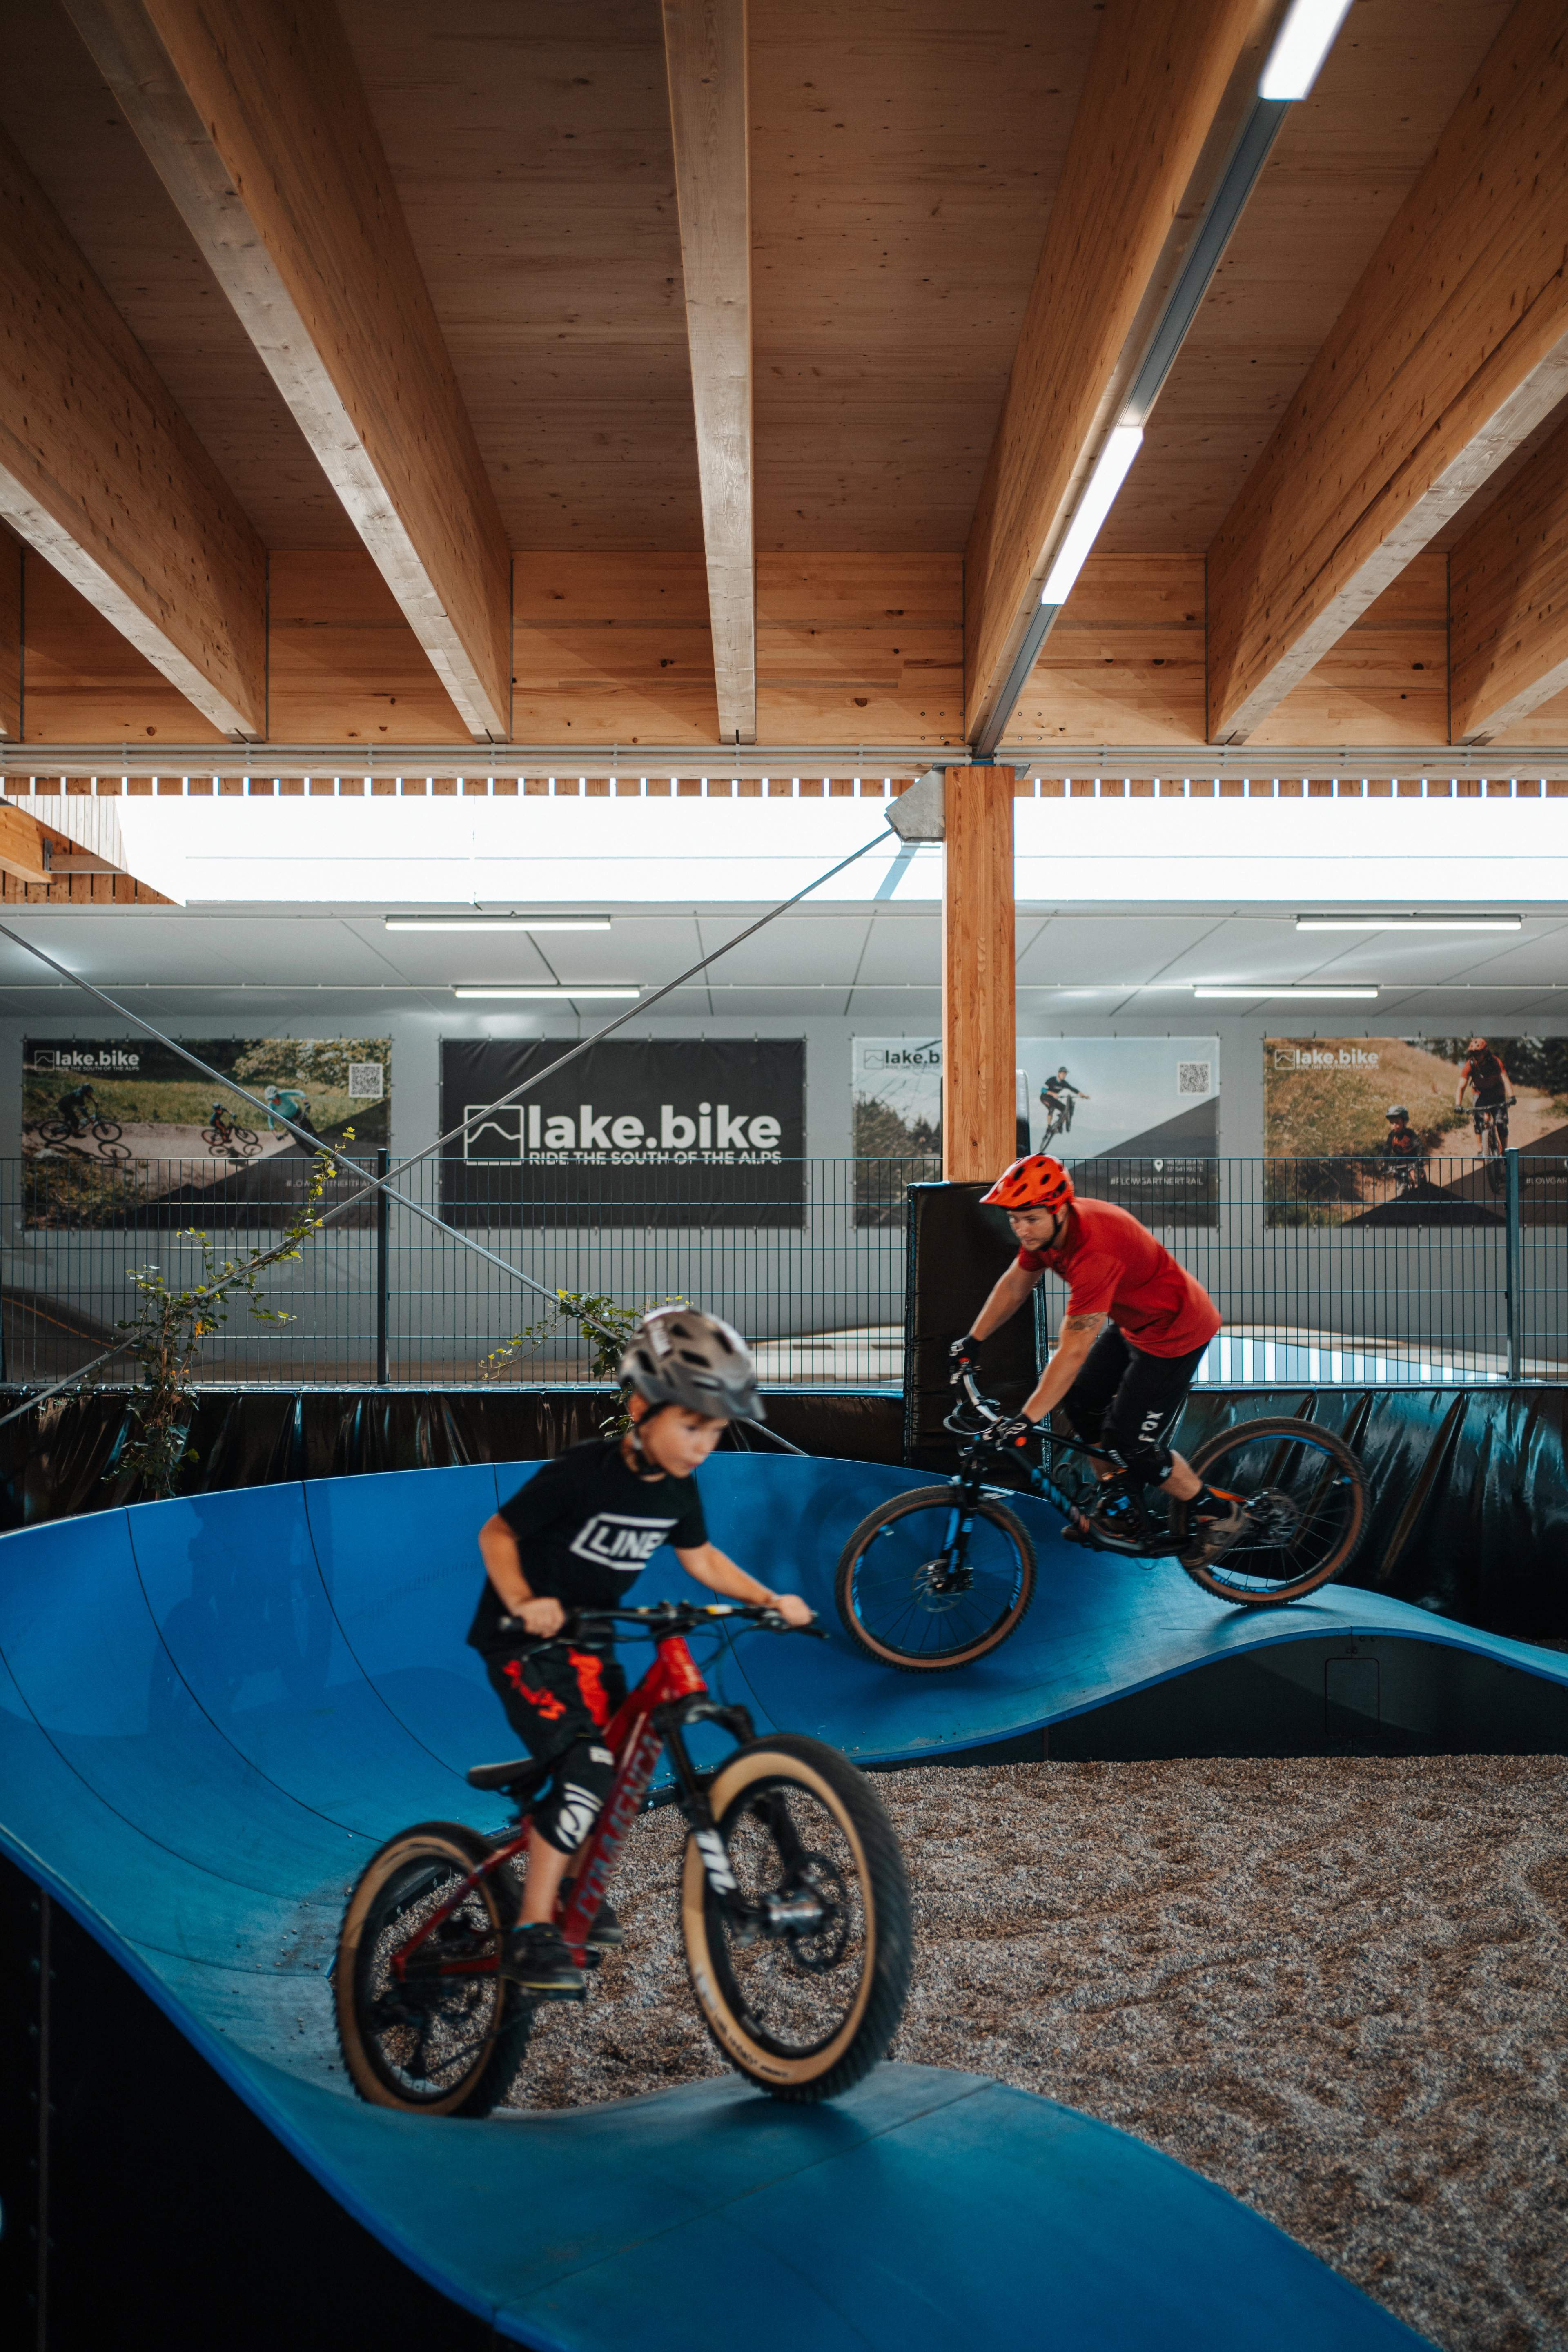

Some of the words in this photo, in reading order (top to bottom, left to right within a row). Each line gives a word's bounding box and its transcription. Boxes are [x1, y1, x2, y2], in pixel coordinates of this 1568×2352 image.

[56, 1050, 140, 1066] lake.bike
[885, 1050, 942, 1064] lake.b
[1296, 1048, 1379, 1065] lake.bike
[529, 1102, 782, 1149] lake.bike
[529, 1151, 569, 1165] RIDE
[573, 1151, 606, 1165] THE
[611, 1151, 669, 1165] SOUTH
[674, 1151, 697, 1165] OF
[701, 1151, 735, 1165] THE
[739, 1151, 782, 1165] ALPS
[1138, 1410, 1164, 1442] FOX
[589, 1526, 670, 1559] LINE
[576, 1721, 664, 1922] COMMENCA
